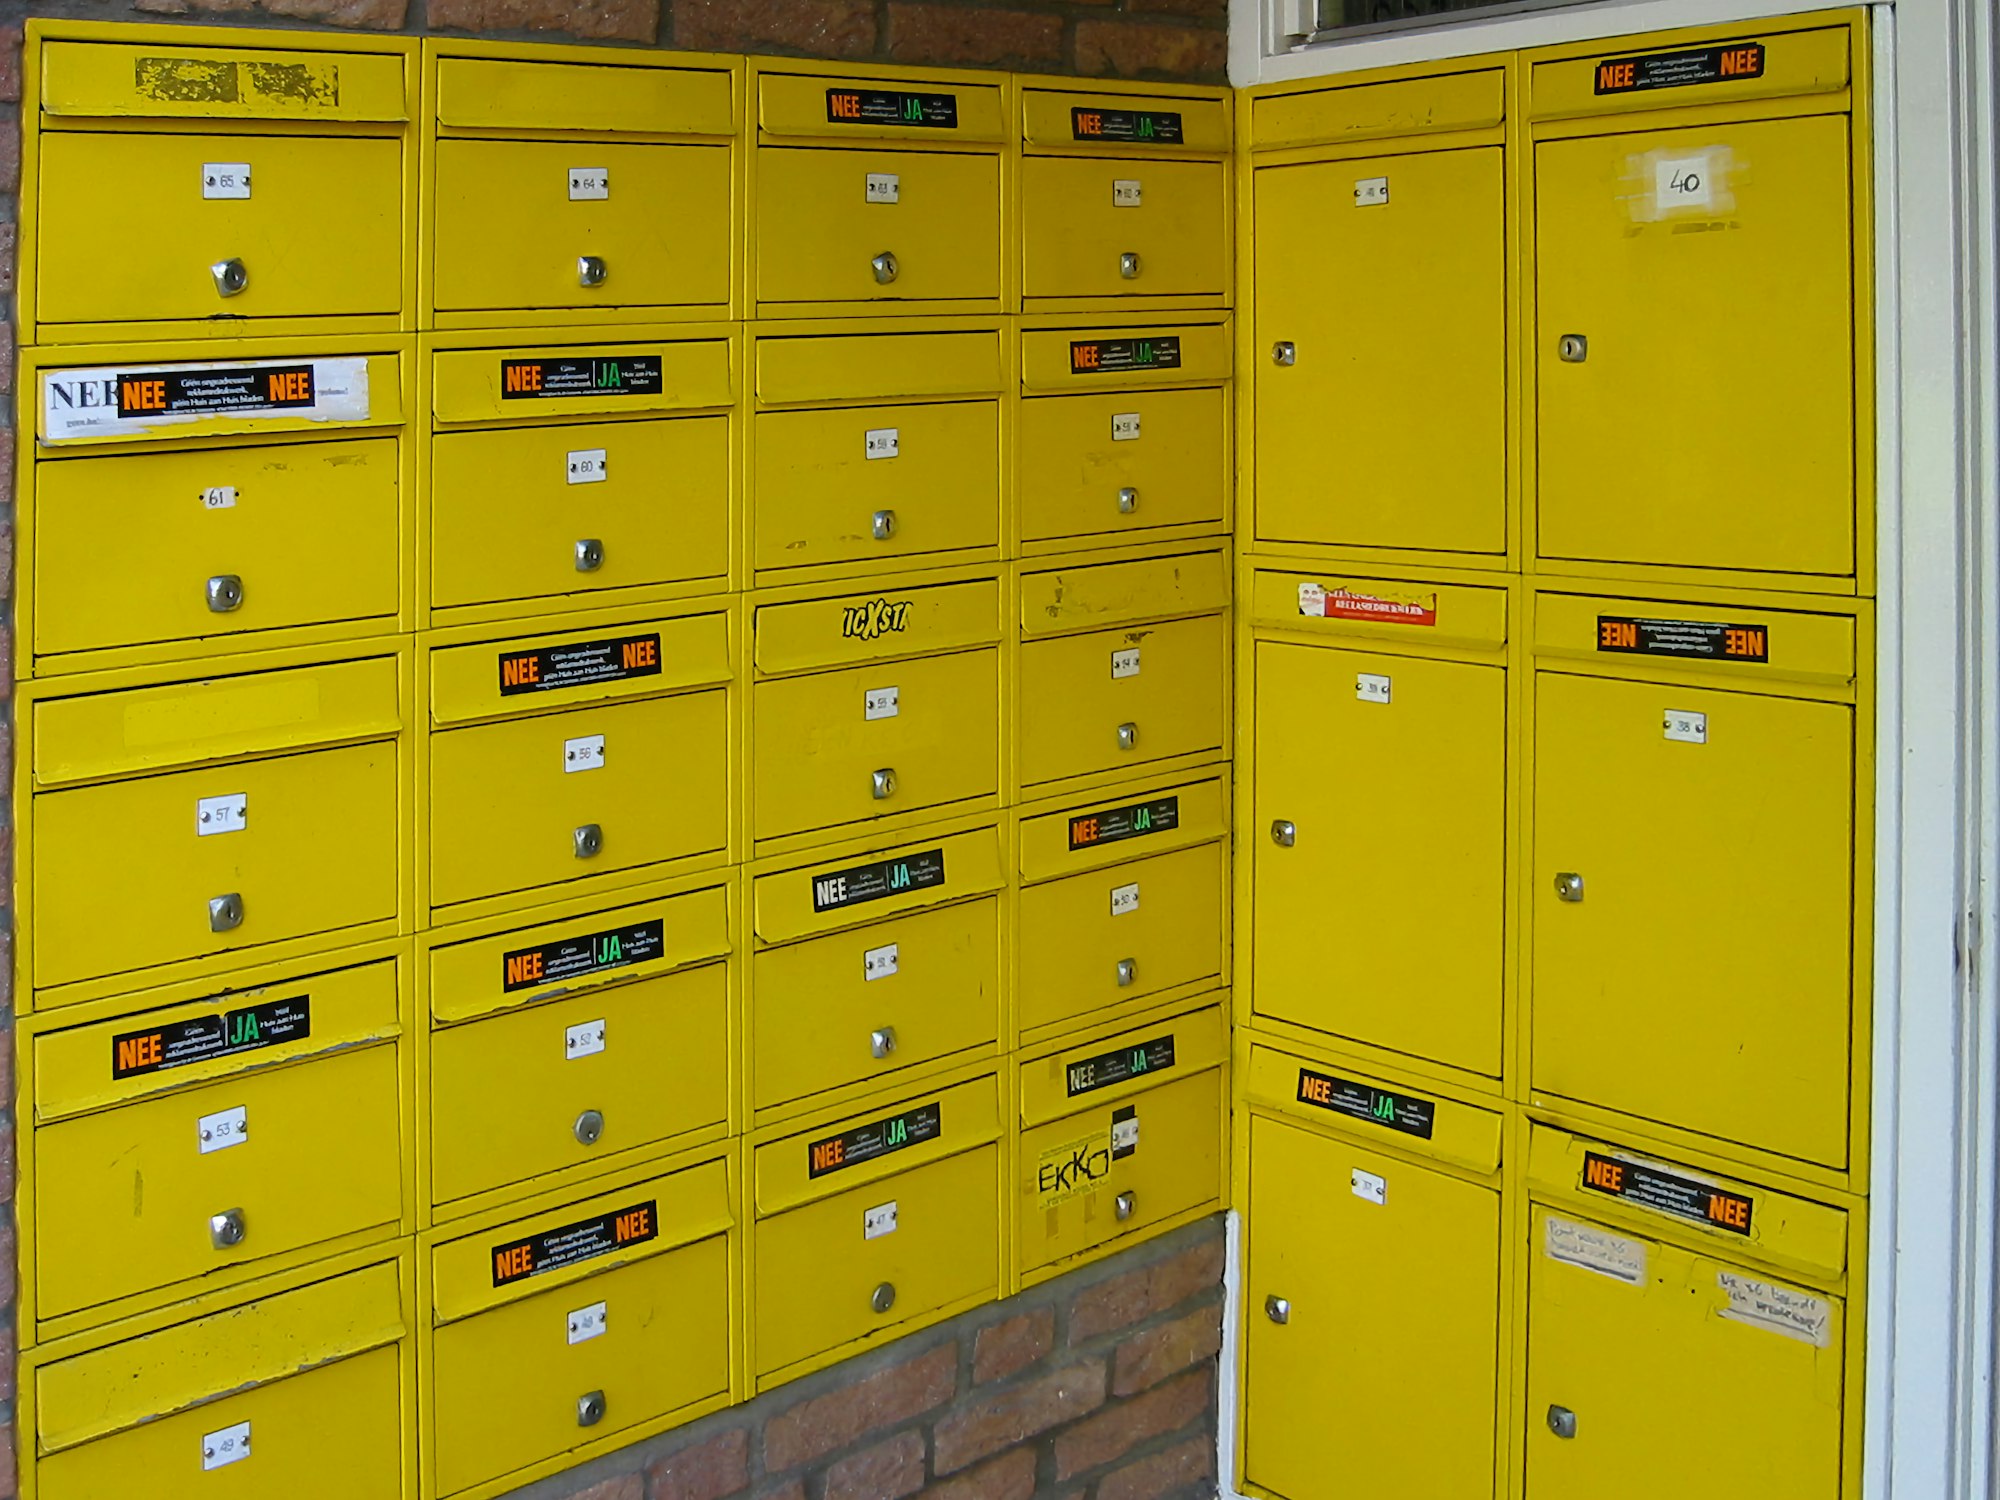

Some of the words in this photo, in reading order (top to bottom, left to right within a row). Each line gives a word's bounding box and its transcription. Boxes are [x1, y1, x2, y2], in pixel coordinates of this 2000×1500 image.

[1600, 64, 1634, 89] NEE
[1721, 49, 1758, 76] NEE
[832, 95, 860, 117] NEE
[904, 99, 922, 120] JA
[1078, 114, 1102, 134] NEE
[1137, 117, 1154, 137] JA
[220, 175, 234, 187] 65
[584, 179, 595, 189] 64
[1670, 169, 1700, 194] 40
[1074, 346, 1098, 368] NEE
[1136, 343, 1152, 362] JA
[123, 381, 166, 410] NEE
[269, 373, 309, 401] NEE
[507, 366, 542, 392] NEE
[598, 363, 621, 387] JA
[209, 490, 223, 505] 61
[1601, 622, 1636, 647] NEE
[1726, 630, 1764, 656] NEE
[504, 656, 539, 686] NEE
[623, 640, 655, 669] NEE
[1677, 721, 1690, 732] 38
[216, 807, 230, 821] 57
[1073, 819, 1098, 844] NEE
[1134, 808, 1150, 830] JA
[817, 877, 847, 906] NEE
[891, 864, 910, 888] JA
[508, 952, 543, 984] NEE
[599, 936, 622, 963] JA
[119, 1034, 162, 1071] NEE
[231, 1014, 260, 1044] JA
[1071, 1064, 1095, 1091] NEE
[1132, 1050, 1147, 1073] JA
[1302, 1076, 1331, 1104] NEE
[1374, 1096, 1394, 1120] JA
[217, 1123, 230, 1136] 53
[814, 1139, 843, 1170] NEE
[888, 1119, 907, 1145] JA
[1039, 1144, 1108, 1192] EKKO
[1588, 1159, 1622, 1191] NEE
[1709, 1195, 1748, 1228] NEE
[496, 1244, 532, 1279] NEE
[616, 1209, 649, 1243] NEE
